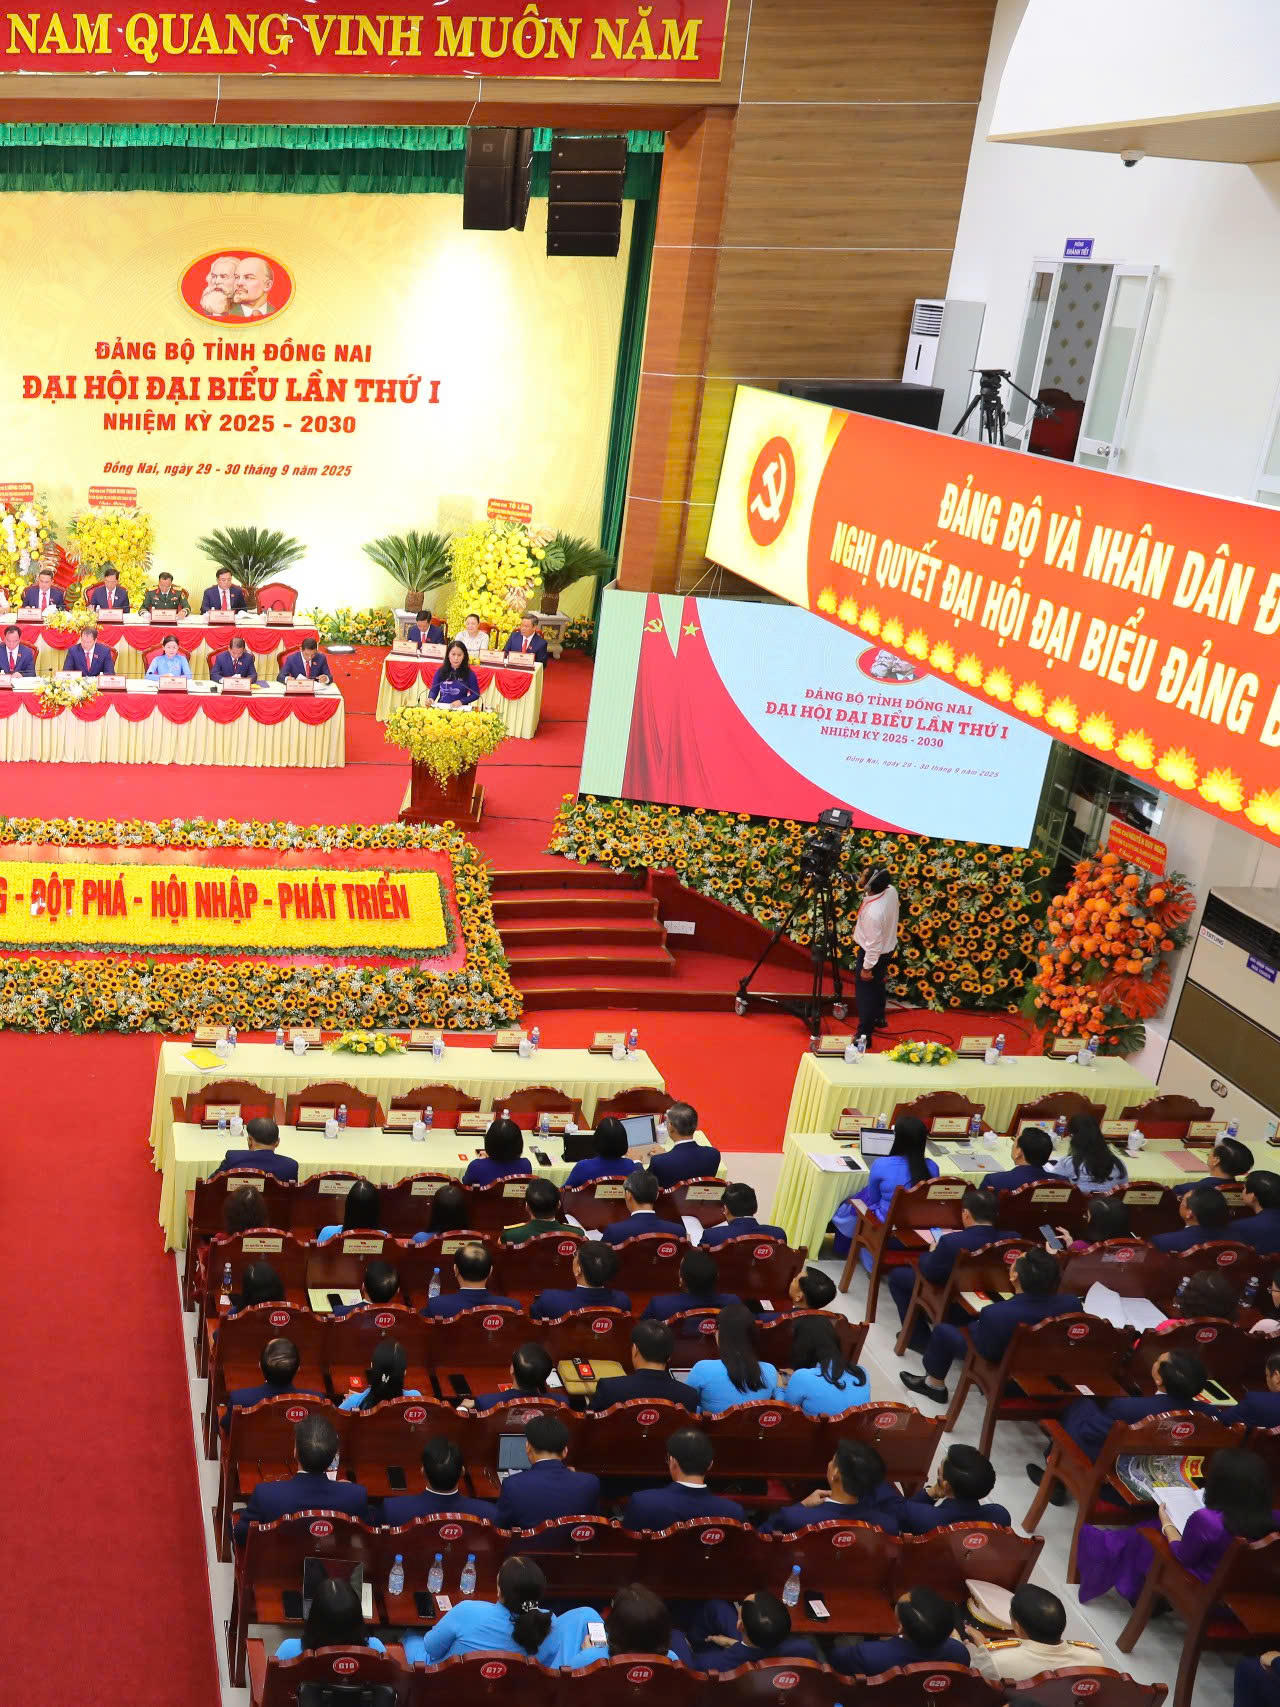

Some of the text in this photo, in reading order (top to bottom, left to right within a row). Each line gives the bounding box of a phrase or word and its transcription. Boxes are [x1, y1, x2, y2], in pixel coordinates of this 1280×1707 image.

[6, 13, 112, 53] NAM
[126, 13, 293, 63] QUANG
[303, 15, 423, 55] VINH
[435, 4, 582, 58] MUÔN
[591, 5, 702, 60] NĂM
[95, 336, 371, 363] ĐẢNG BỘ TỈNH ĐỒNG NAI
[23, 366, 440, 405] ĐẠI HỘI ĐẠI BIỂU LẦN THỨ I
[104, 410, 355, 433] NHIỆM KỲ 2025 2030
[103, 462, 352, 477] Đồng Nai, ngày 29 30 tháng 9 năm 2025
[937, 474, 1002, 546] ĐẢNG
[1001, 495, 1044, 568] BỘ
[1044, 506, 1083, 573] VÀ
[1082, 522, 1175, 600] NHÂN
[1172, 543, 1256, 626] DÂN
[829, 521, 877, 586] NGHỊ
[876, 539, 942, 603] QUYẾT
[939, 564, 983, 628] ĐẠI
[984, 575, 1031, 648] HỘI
[1029, 598, 1082, 669] ĐẠI
[1080, 606, 1158, 693] BIỂU
[1156, 639, 1259, 735] ĐẢNG
[804, 686, 974, 715] ĐẢNG BỘ TỈNH ĐỒNG NAI
[765, 701, 1009, 740] ĐẠI HỘI ĐẠI BIỂU LẦN THỨ I
[820, 726, 944, 748] NHIỆM KỲ 2025 2030
[32, 872, 75, 921] ĐỘT
[83, 874, 126, 916] PHÁ
[152, 875, 187, 924] HỘI
[196, 876, 257, 923] NHẬP
[279, 879, 336, 919] PHÁT
[341, 872, 411, 919] TRIỂN
